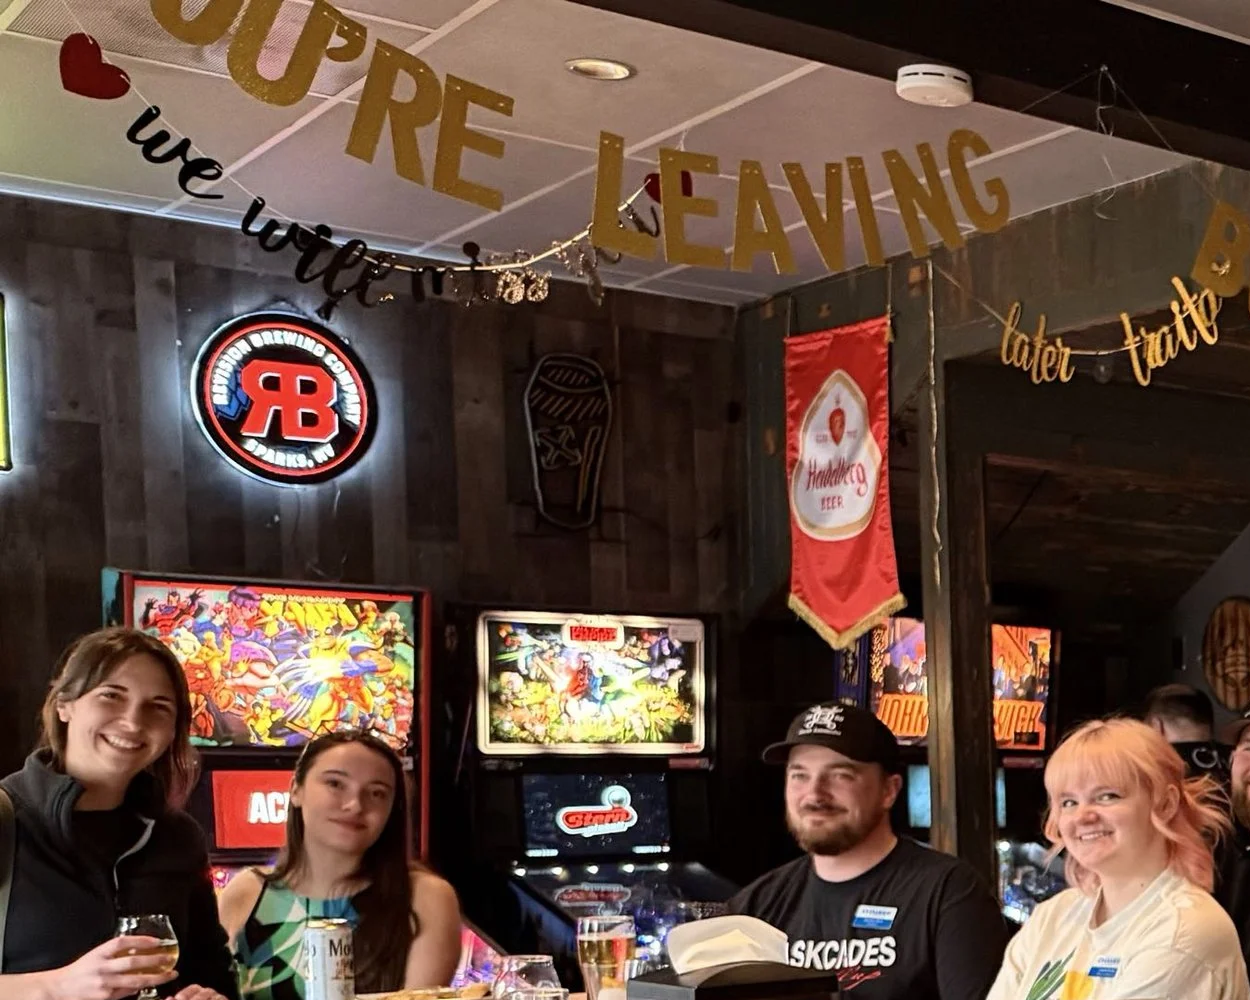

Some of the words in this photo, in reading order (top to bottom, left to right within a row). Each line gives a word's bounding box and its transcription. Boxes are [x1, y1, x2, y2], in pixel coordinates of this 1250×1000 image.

[126, 105, 224, 199] we
[591, 129, 1011, 275] LEAVING
[212, 338, 252, 405] REVISION
[248, 329, 327, 358] BREWING
[324, 353, 361, 426] COMPANY
[1000, 301, 1075, 386] later
[820, 496, 844, 511] BEER
[786, 935, 897, 971] SKCADES
